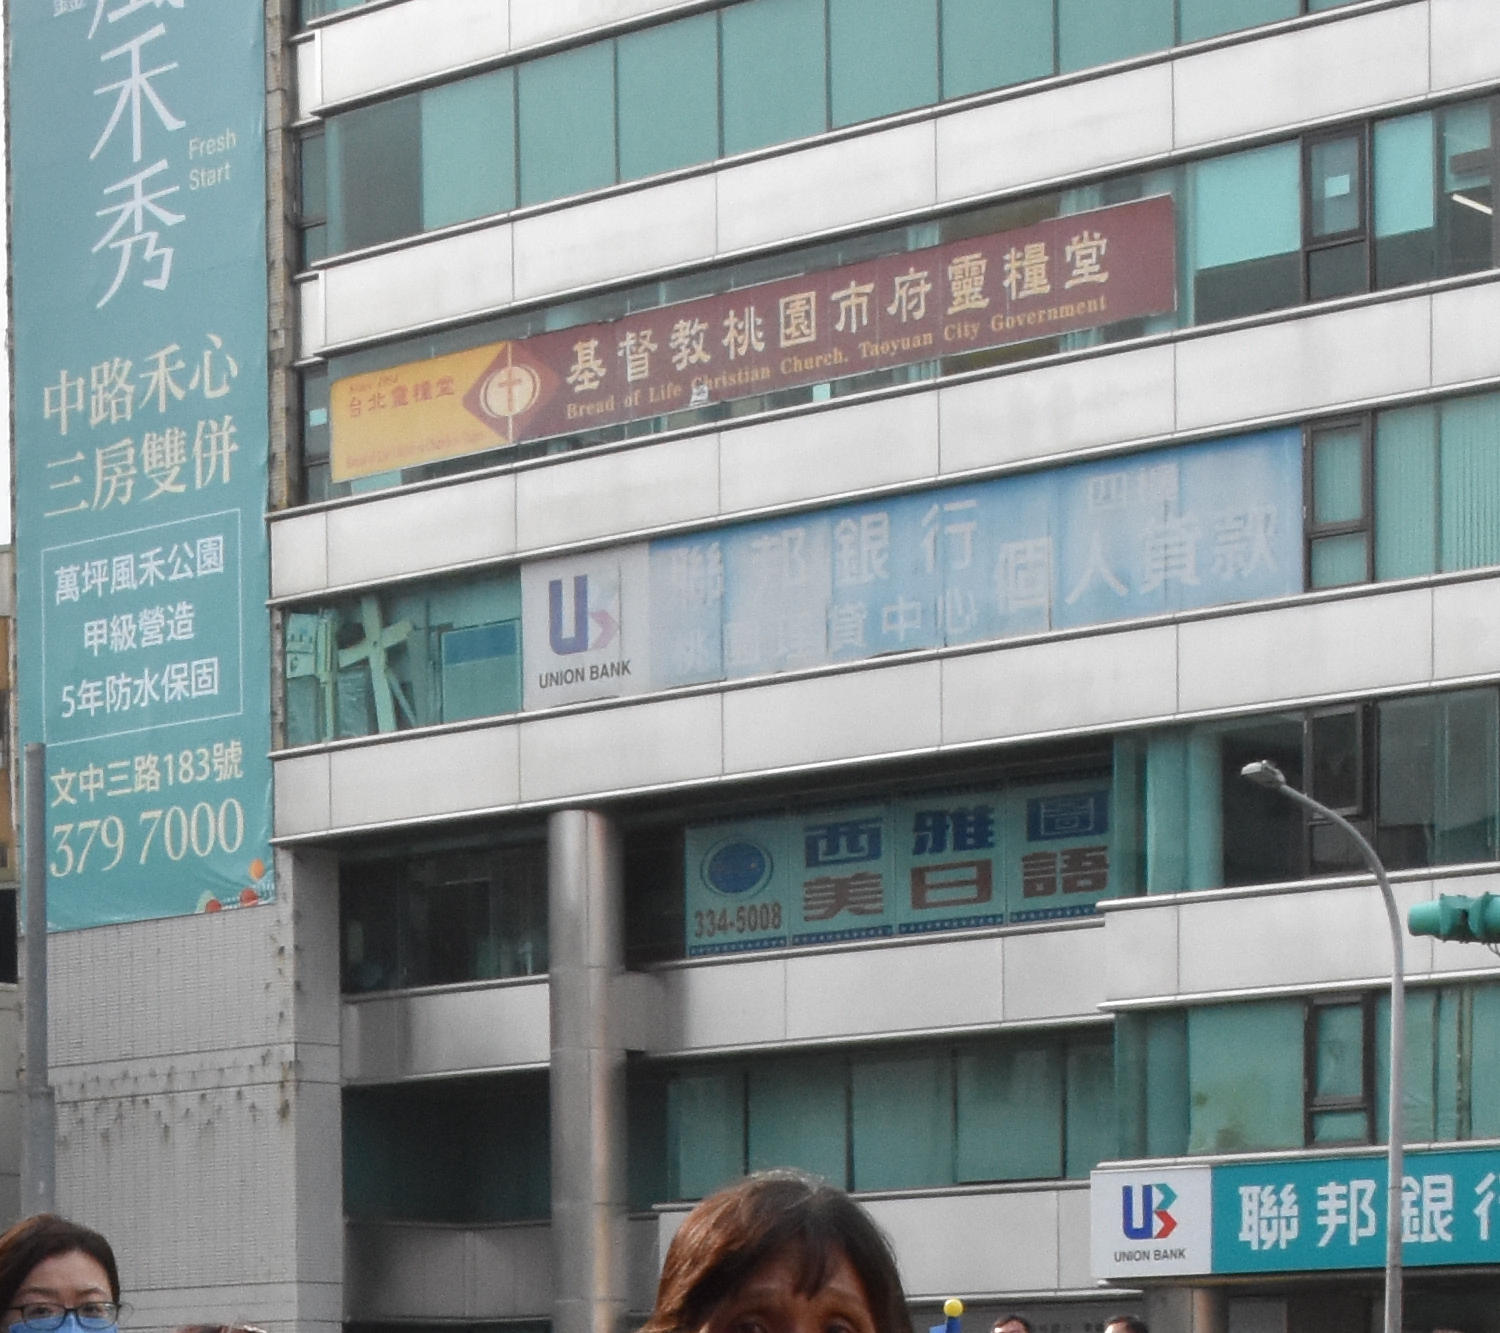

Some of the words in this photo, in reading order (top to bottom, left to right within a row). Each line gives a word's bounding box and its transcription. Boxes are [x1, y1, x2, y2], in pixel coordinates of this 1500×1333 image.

[188, 128, 237, 160] Fresh
[188, 161, 232, 191] Start
[565, 229, 1110, 393] 基督教桃園市府靈糧堂
[43, 332, 239, 437] 中路禾心
[566, 398, 616, 420] Bread
[624, 394, 640, 408] of
[648, 382, 682, 403] Life
[857, 330, 934, 359] Taoyuan
[943, 321, 980, 343] City
[991, 295, 1107, 333] Government
[43, 414, 240, 518] 三房雙併
[54, 534, 224, 606] 萬坪風禾公園
[83, 600, 196, 657] 甲級營造
[61, 656, 219, 718] 5年防水保固
[539, 669, 586, 689] UNION
[590, 660, 632, 682] BANK
[50, 740, 244, 808] 文中三路183號
[50, 814, 126, 879] 379
[138, 797, 246, 866] 7000
[694, 902, 783, 939] 334-5008
[1113, 1250, 1151, 1263] UNION
[1153, 1248, 1187, 1261] BANK
